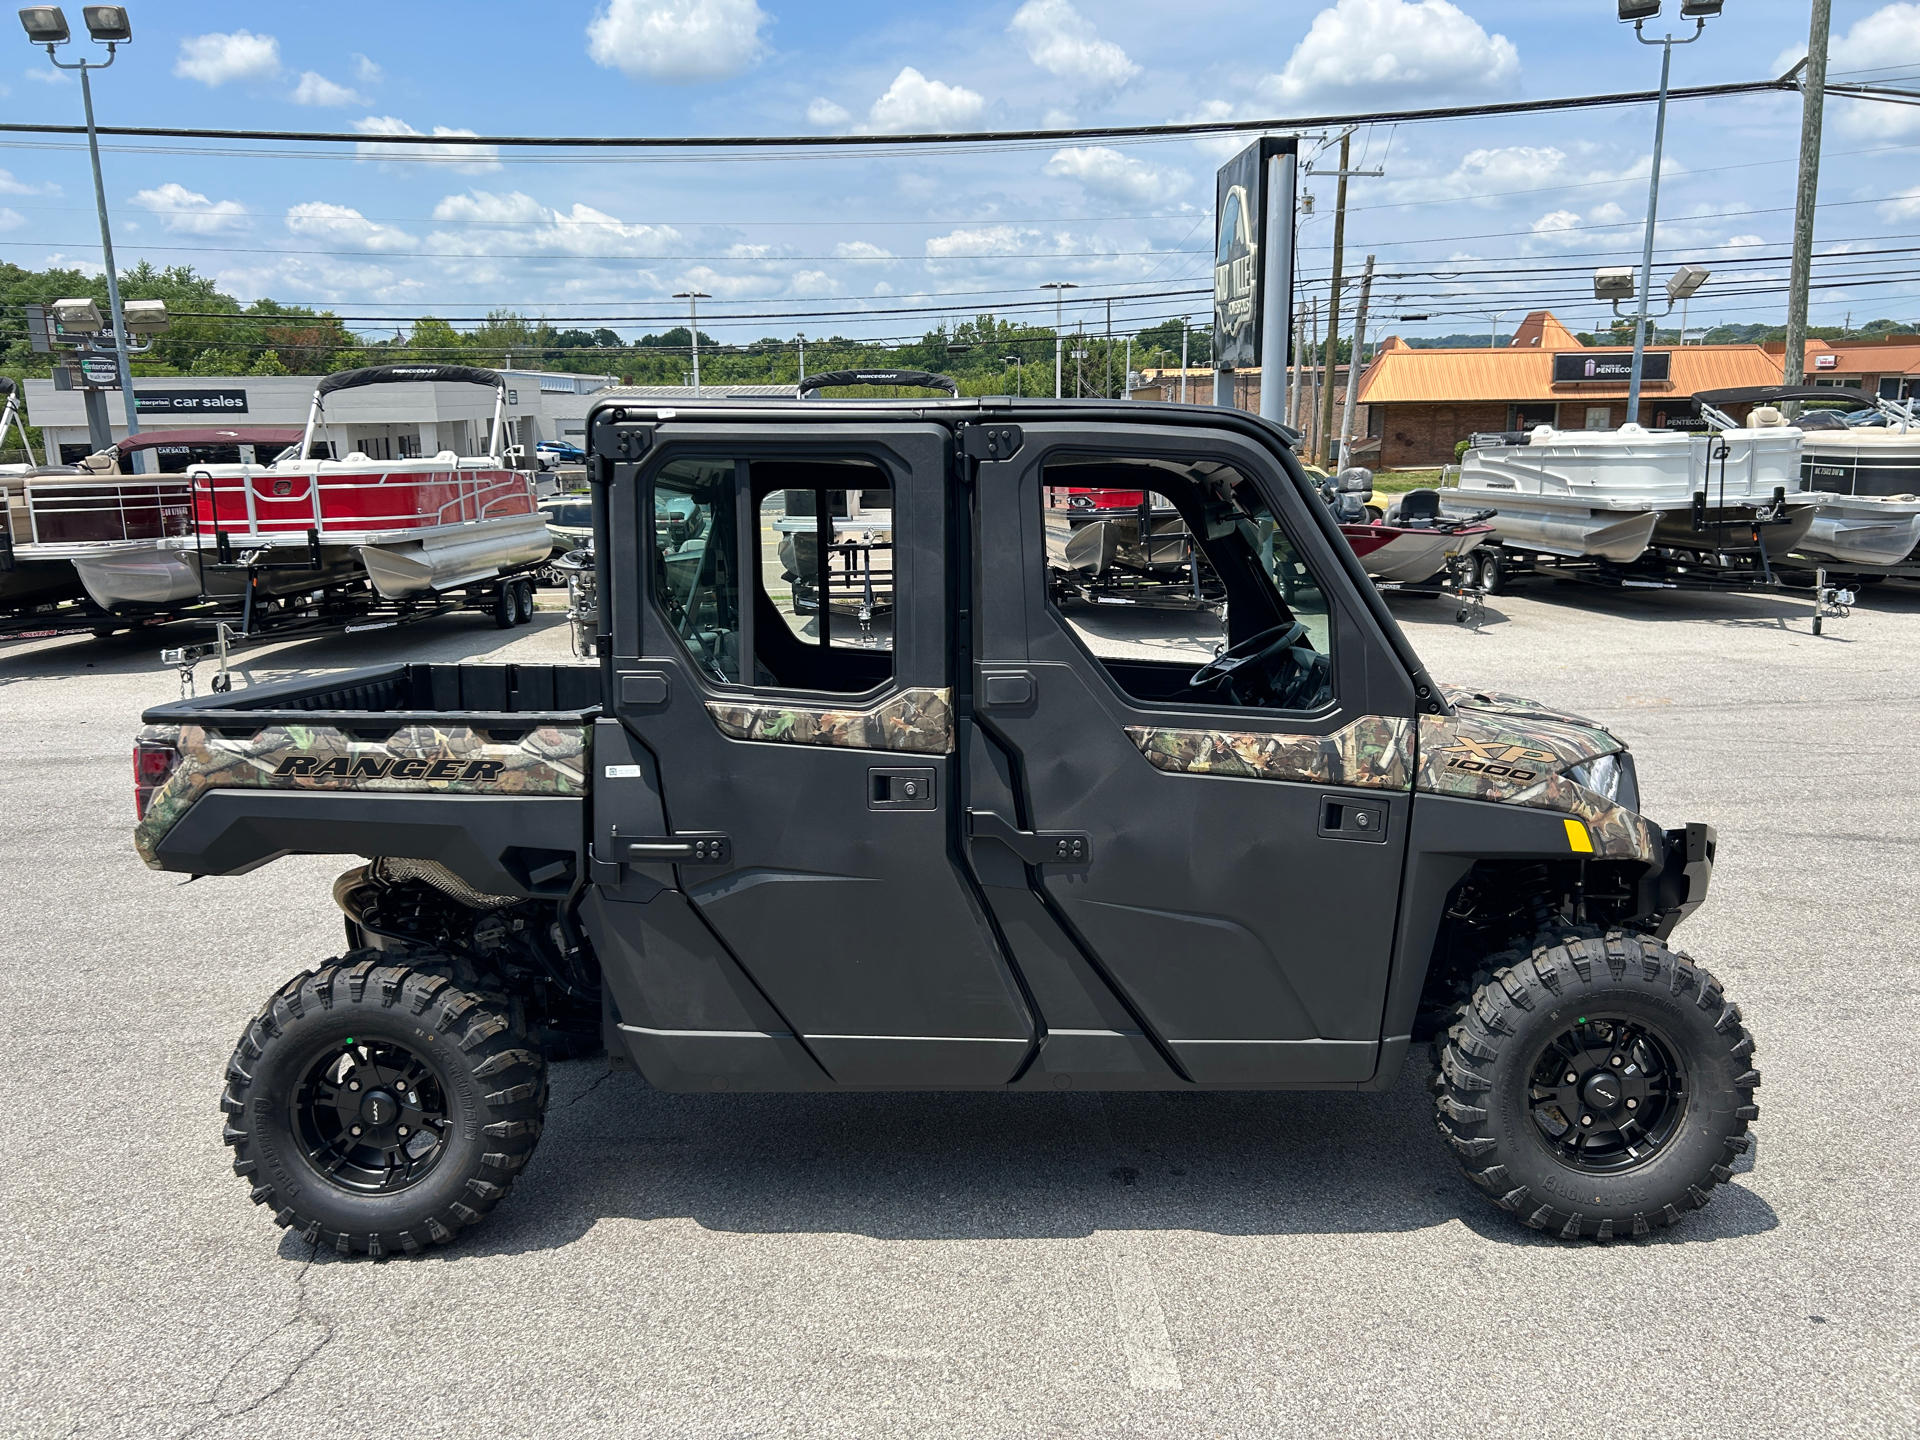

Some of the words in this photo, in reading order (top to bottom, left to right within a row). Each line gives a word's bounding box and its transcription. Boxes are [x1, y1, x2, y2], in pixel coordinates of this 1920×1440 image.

[84, 362, 116, 372] enterprise
[173, 398, 199, 408] car
[203, 395, 244, 407] sales
[1432, 734, 1558, 764] XP
[273, 754, 506, 782] RANGER
[1446, 757, 1537, 781] 1000
